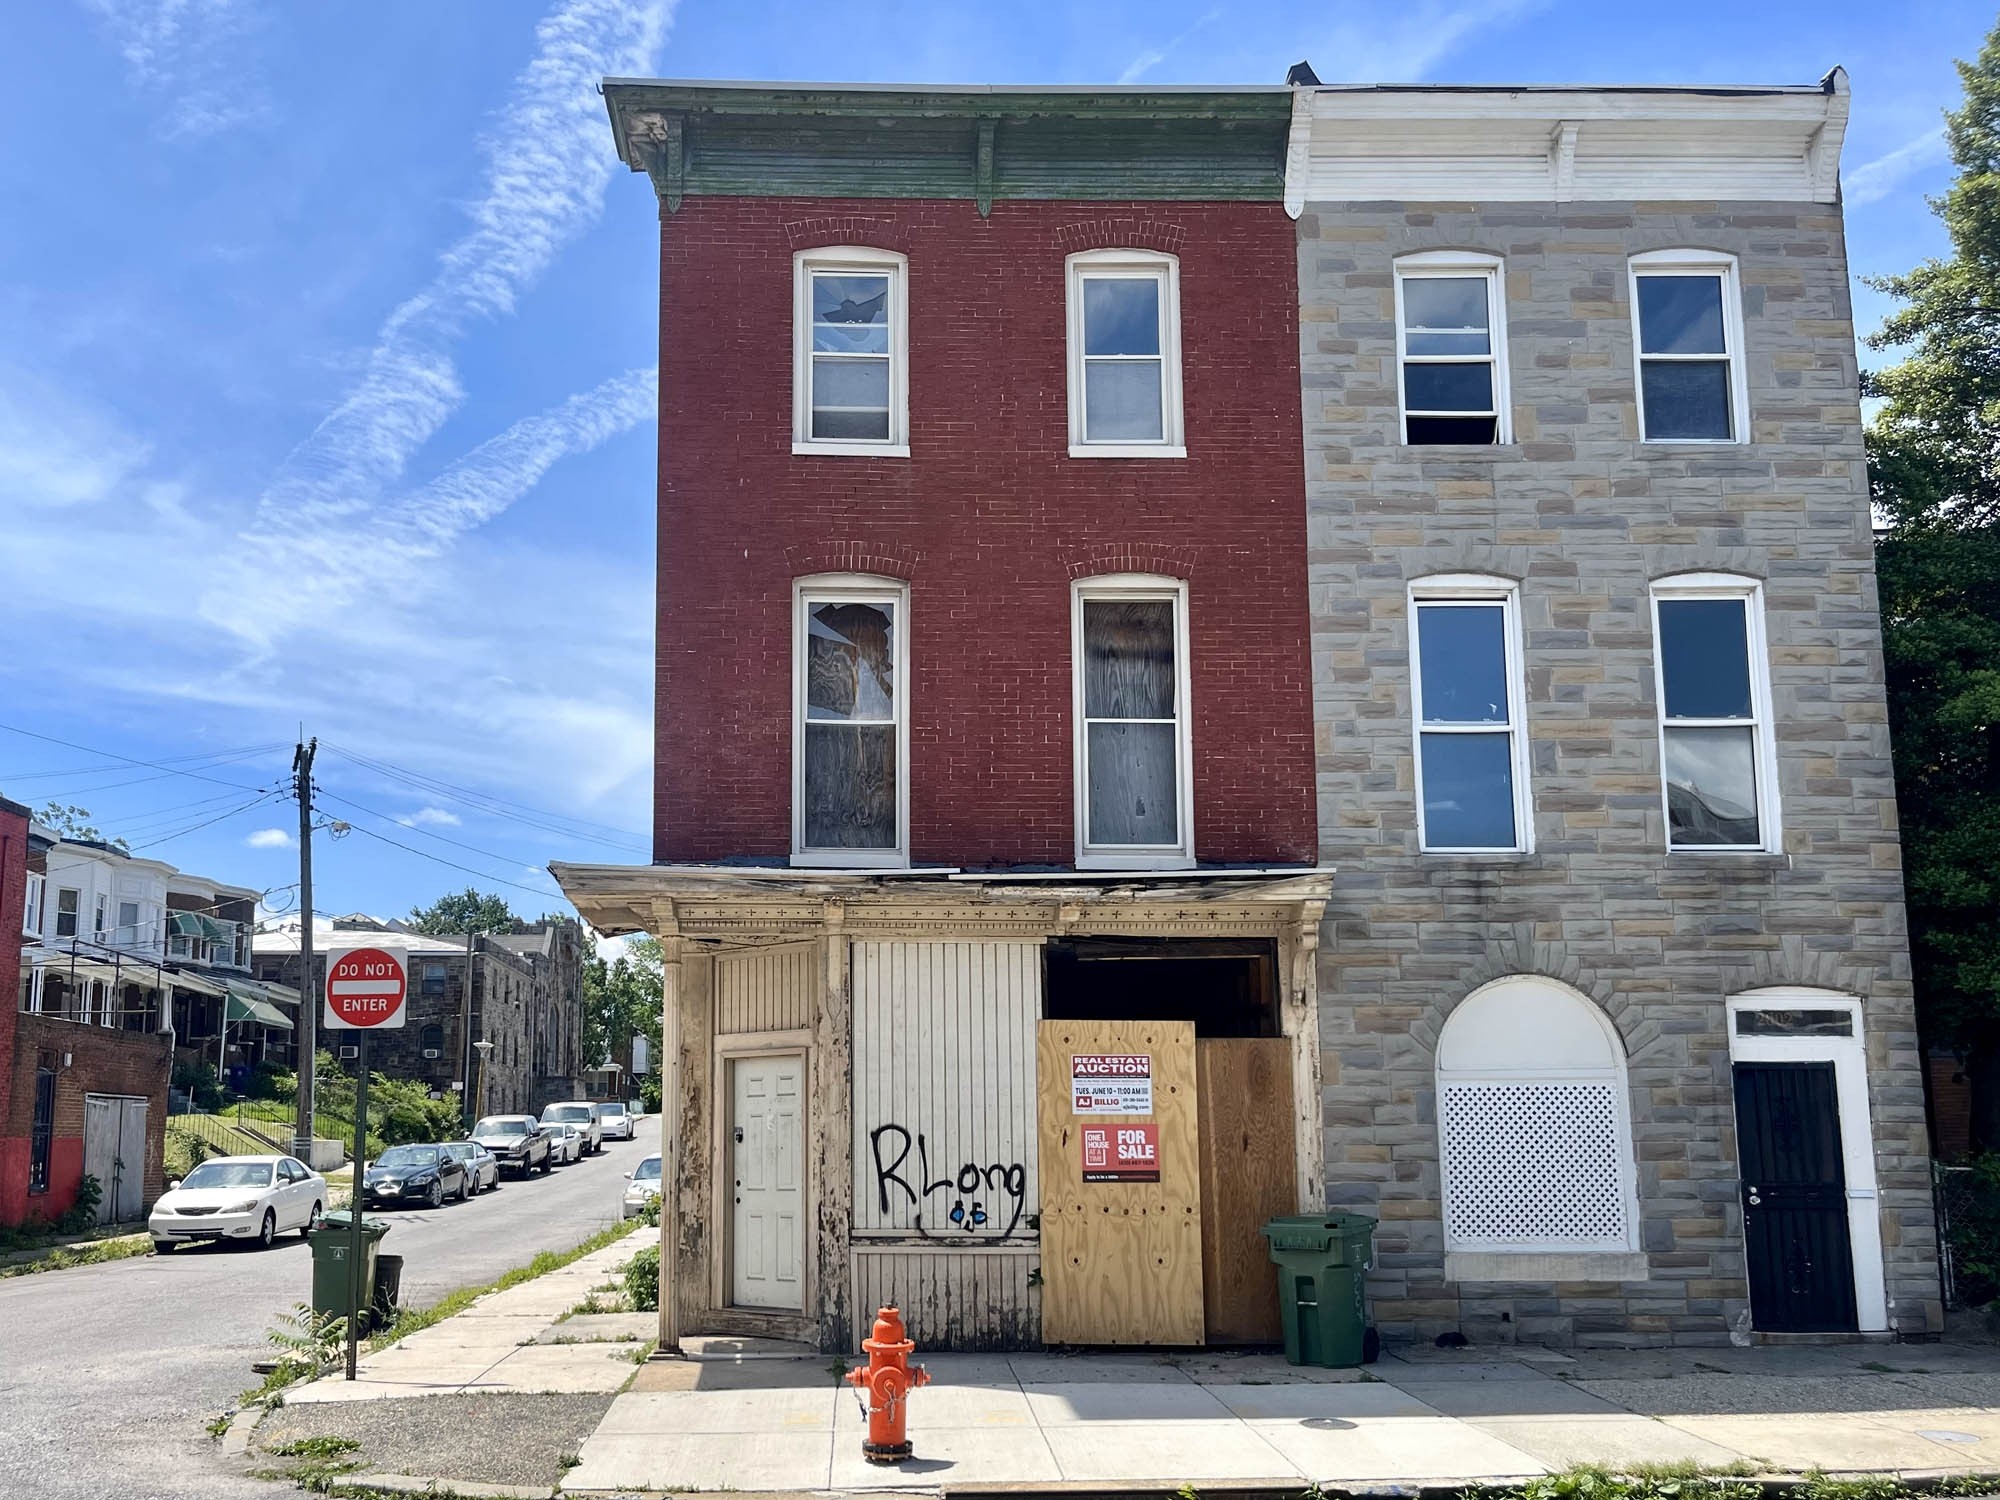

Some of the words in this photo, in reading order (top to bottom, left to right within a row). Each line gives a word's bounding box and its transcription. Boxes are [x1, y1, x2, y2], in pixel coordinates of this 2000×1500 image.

[339, 963, 358, 976] DO
[365, 963, 394, 976] NOT
[343, 999, 387, 1011] ENTER
[1074, 1064, 1149, 1073] AUCTION
[1075, 1087, 1090, 1095] TUES.
[1092, 1087, 1106, 1095] JUNE
[1106, 1087, 1113, 1095] 10
[1117, 1087, 1131, 1095] 11:00
[1131, 1087, 1141, 1095] AM
[1078, 1098, 1090, 1106] AJ
[1094, 1098, 1120, 1106] BILLIG
[1117, 1130, 1146, 1145] FOR
[1088, 1141, 1110, 1149] HOUSE
[1118, 1144, 1155, 1159] SALE
